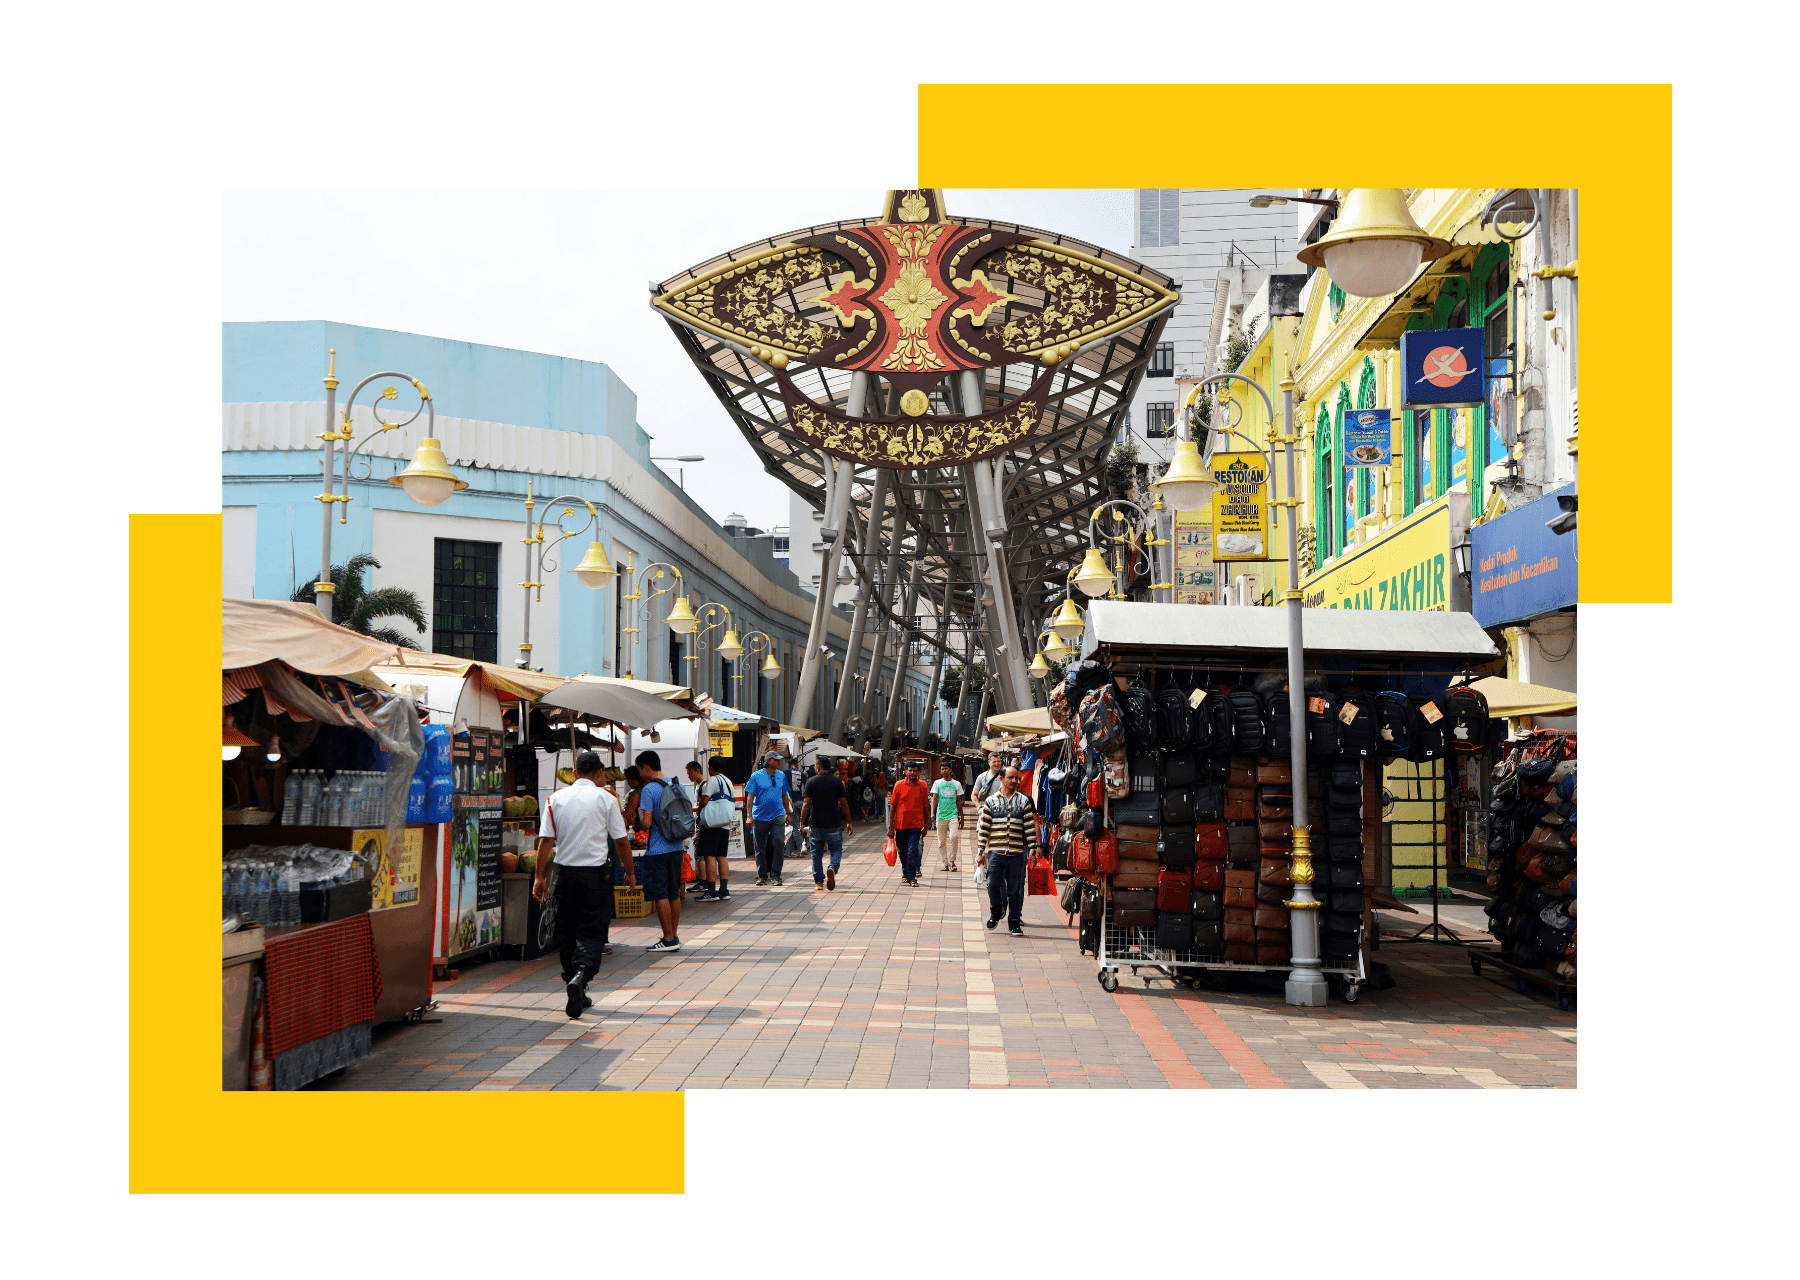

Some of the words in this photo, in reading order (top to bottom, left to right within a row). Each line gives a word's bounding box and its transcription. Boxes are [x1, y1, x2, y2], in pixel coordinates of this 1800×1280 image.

[1221, 504, 1258, 515] ZAKHIR
[1480, 554, 1495, 573] Kedai
[1496, 545, 1518, 567] Produk
[1480, 574, 1507, 594] Kesihatan
[1509, 568, 1520, 584] dan
[1521, 556, 1558, 580] Kecantikan
[1379, 553, 1445, 611] ZAKHIR
